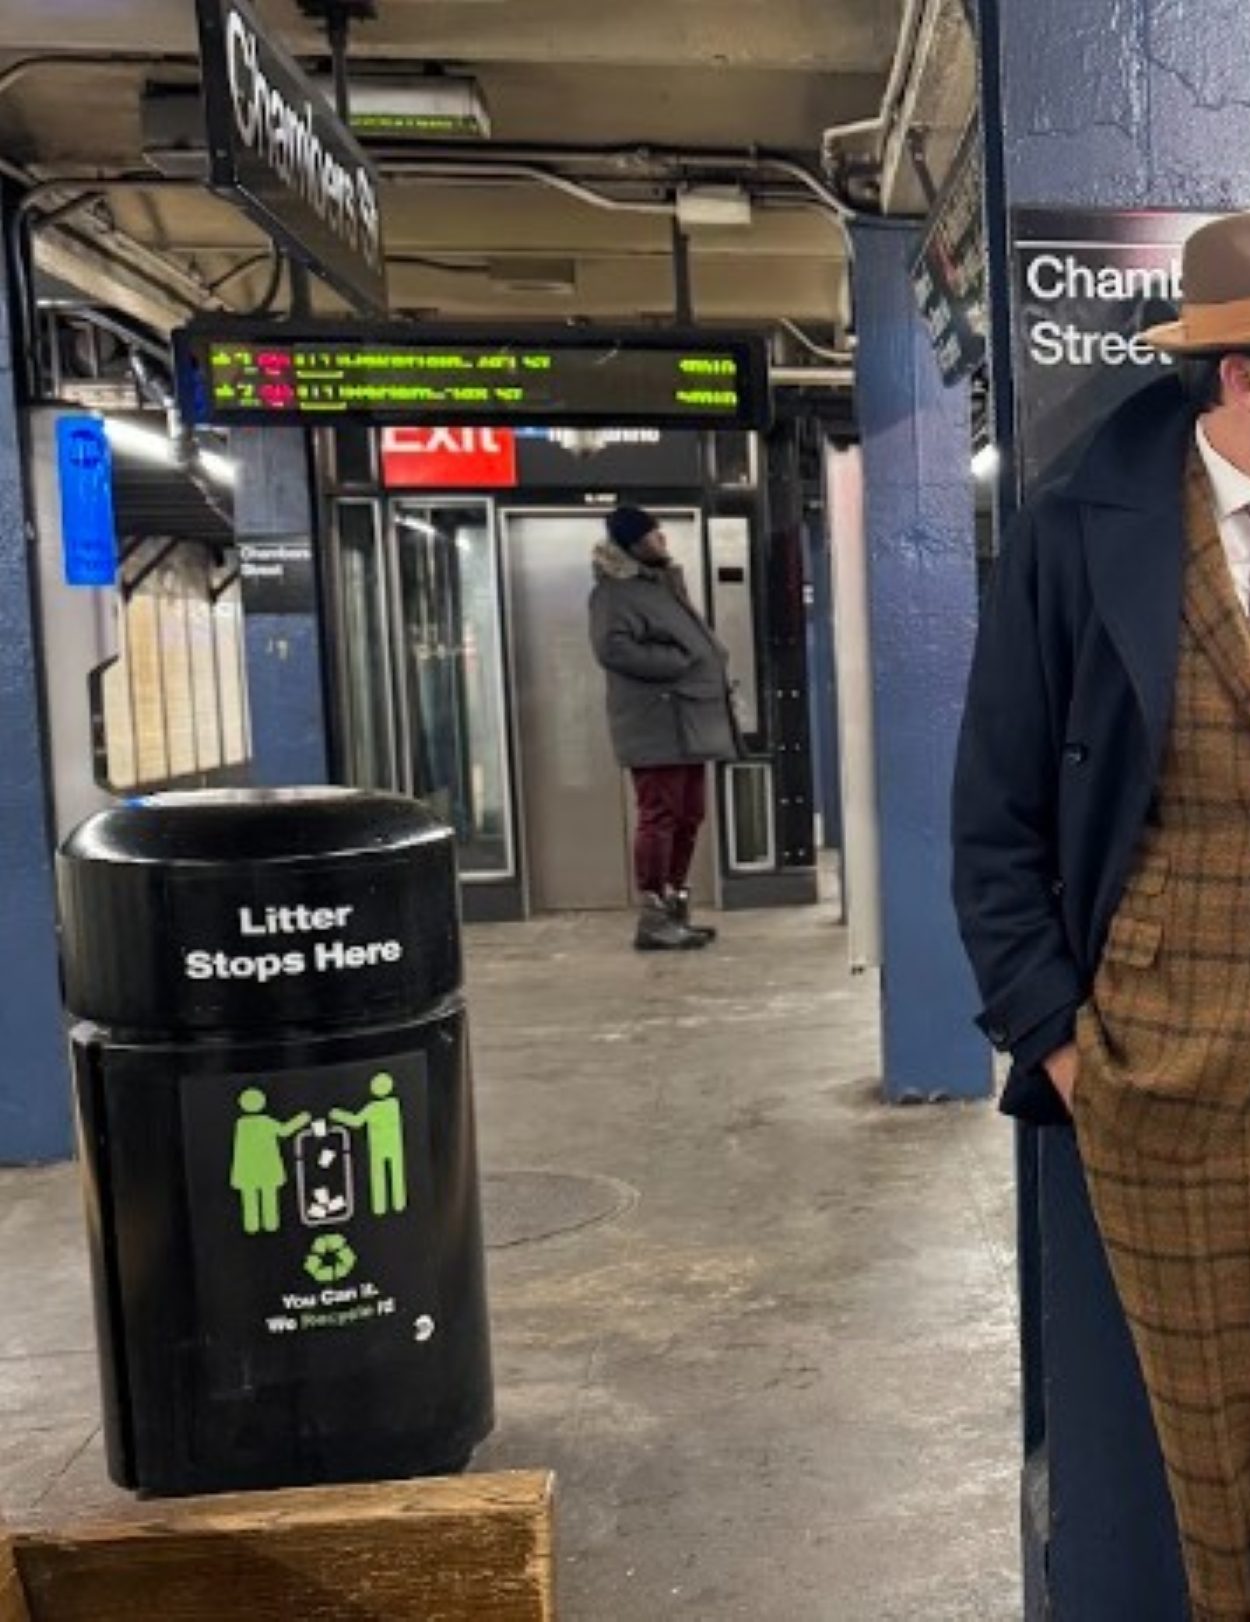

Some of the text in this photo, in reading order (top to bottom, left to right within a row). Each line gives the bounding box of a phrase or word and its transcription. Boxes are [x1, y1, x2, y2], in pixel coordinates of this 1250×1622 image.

[226, 10, 358, 253] Chambers
[238, 904, 354, 936] Litter
[185, 939, 402, 983] Stops Here
[282, 1294, 316, 1309] You
[321, 1287, 358, 1305] Can
[265, 1314, 298, 1334] We
